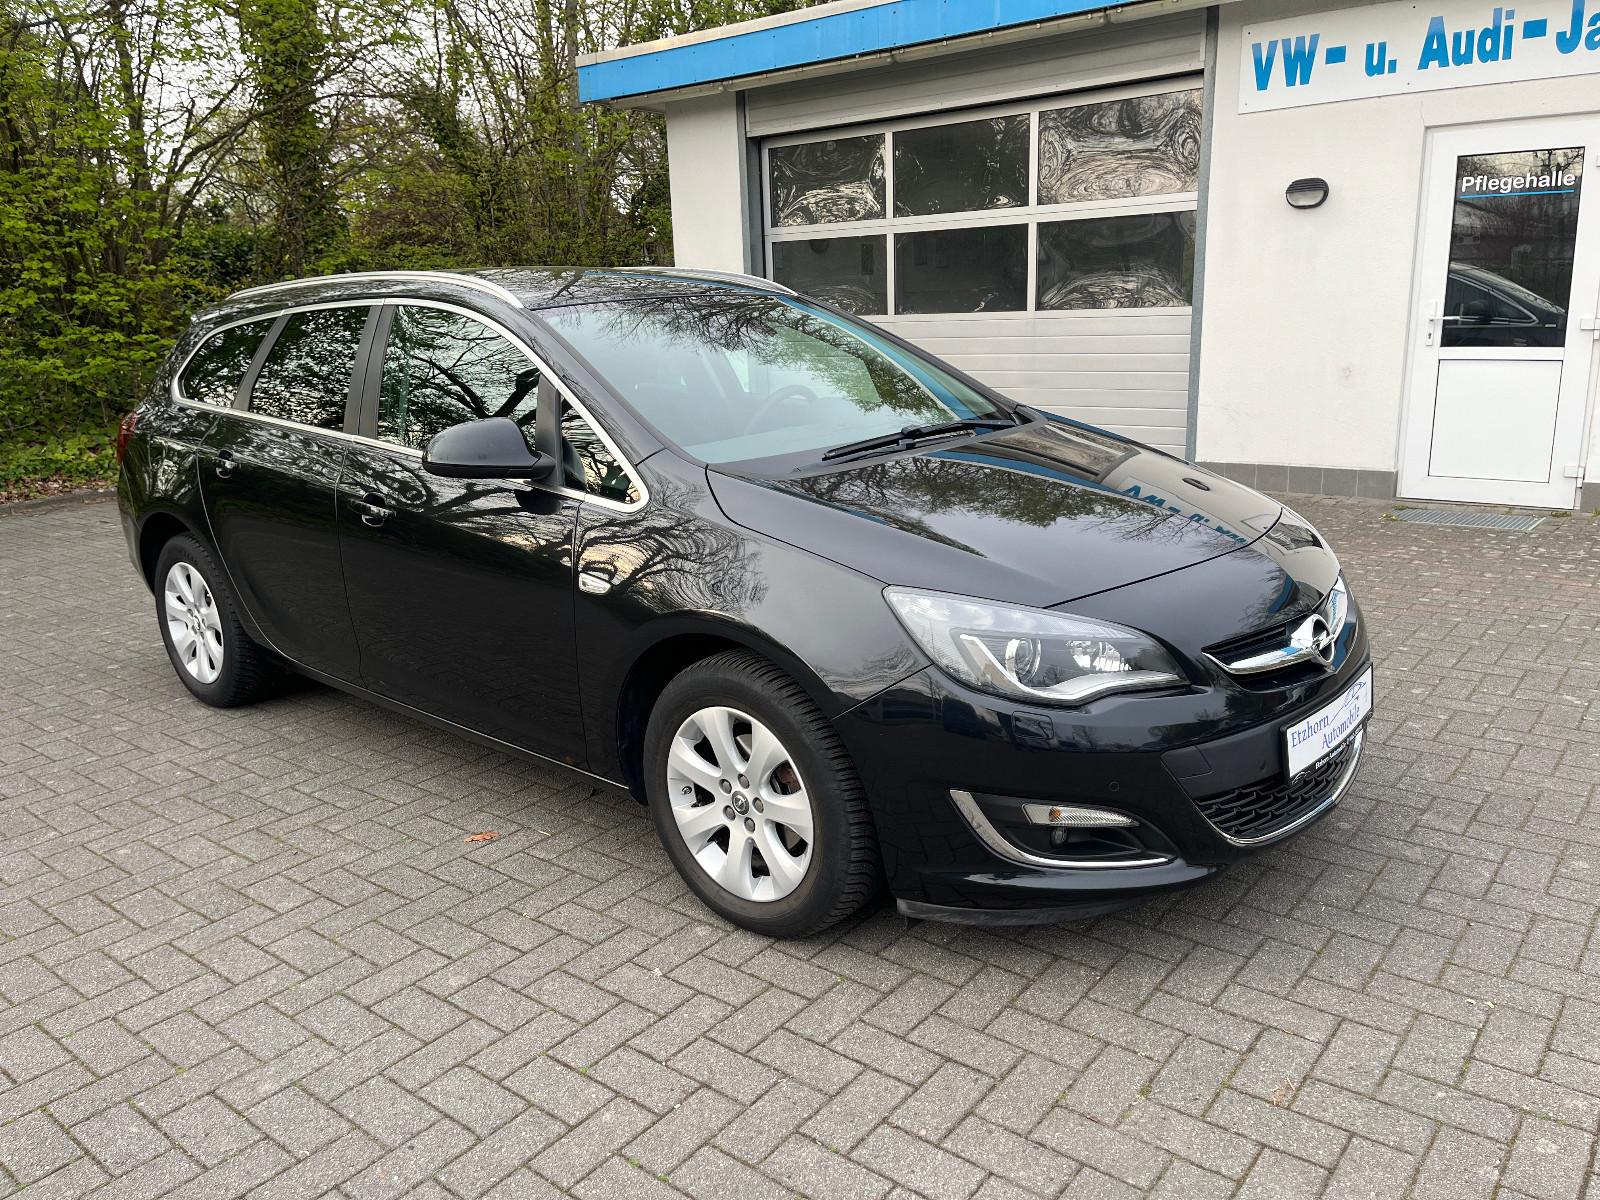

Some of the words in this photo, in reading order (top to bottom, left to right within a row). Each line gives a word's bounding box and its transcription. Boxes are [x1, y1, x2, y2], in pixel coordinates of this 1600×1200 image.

[1365, 42, 1398, 78] u.
[1461, 170, 1576, 193] Pflegehalle
[1291, 715, 1330, 748] Etzhorn
[1321, 703, 1360, 750] Automobile
